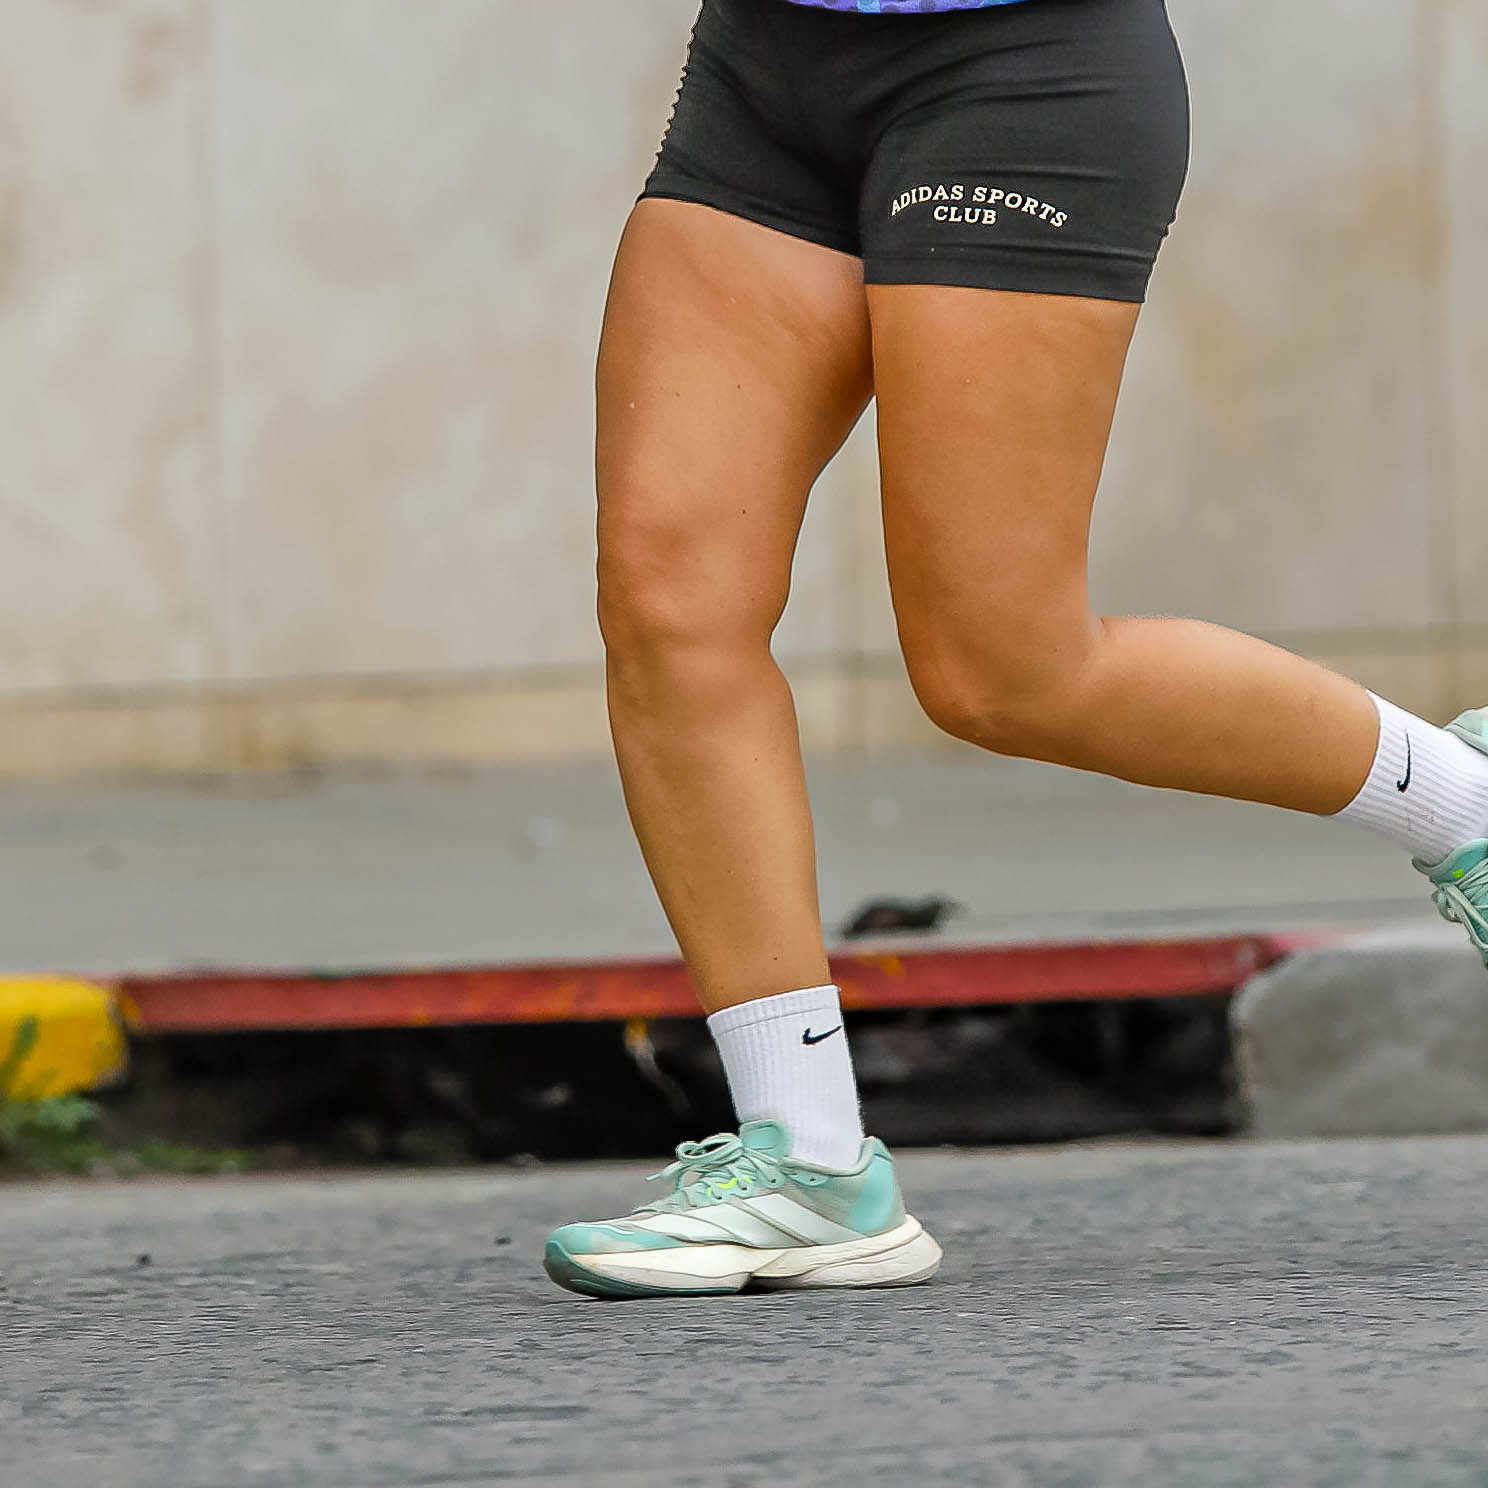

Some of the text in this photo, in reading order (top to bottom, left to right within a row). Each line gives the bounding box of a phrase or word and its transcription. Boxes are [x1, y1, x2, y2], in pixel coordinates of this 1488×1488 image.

[891, 184, 1068, 228] ADIDAS SPORTS
[933, 205, 997, 225] CLUB
